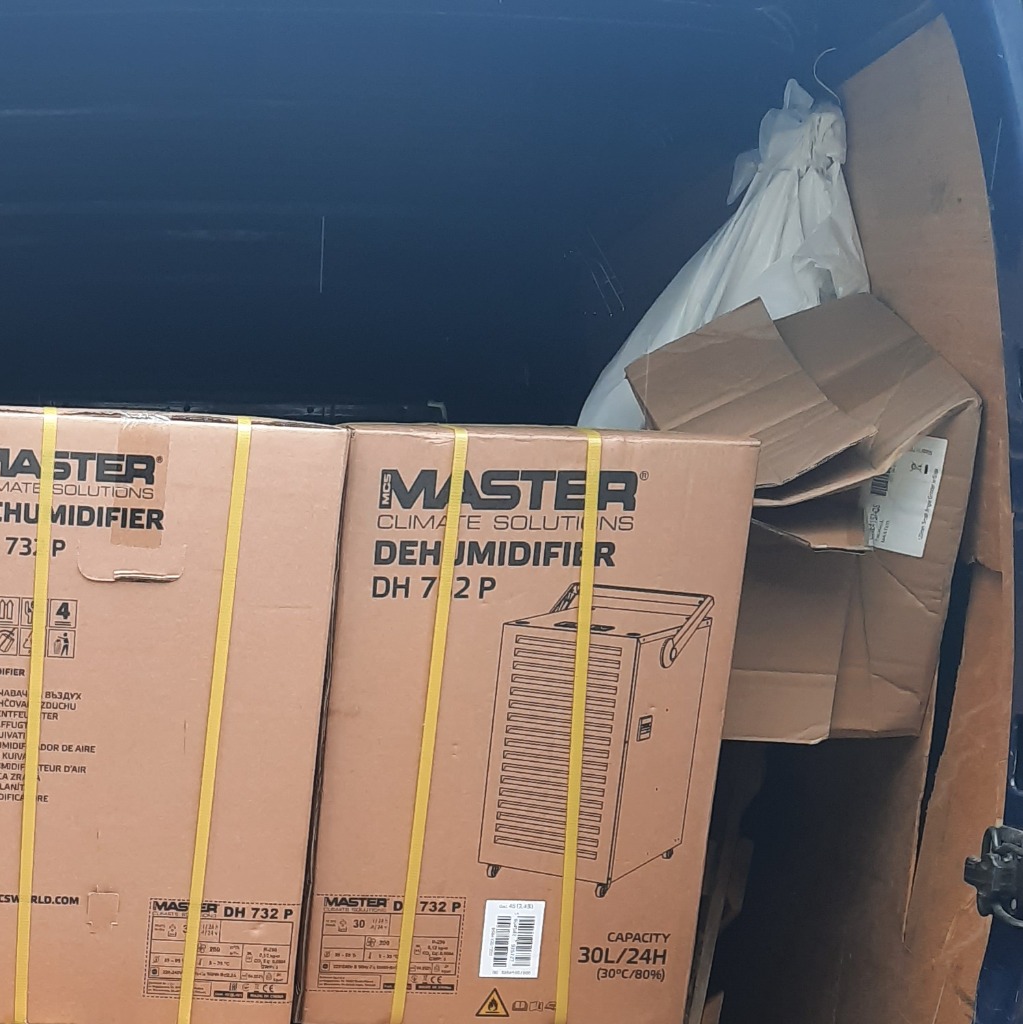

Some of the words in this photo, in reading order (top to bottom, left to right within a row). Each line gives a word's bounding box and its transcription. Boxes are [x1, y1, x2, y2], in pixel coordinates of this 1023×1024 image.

[52, 484, 154, 500] SOLUTIONS
[380, 472, 391, 505] MCS
[388, 469, 638, 511] MASTER
[493, 515, 634, 531] SOLUTINS
[5, 537, 40, 557] 73
[52, 539, 66, 557] P
[372, 576, 410, 598] DH
[421, 576, 471, 599] 72
[478, 576, 496, 599] P
[55, 602, 71, 620] 4
[74, 745, 96, 753] AIRE
[63, 765, 87, 774] D'AIR
[153, 901, 218, 913] MASER
[223, 906, 246, 918] DH
[251, 907, 279, 919] 732
[283, 909, 294, 920] P
[324, 897, 388, 908] MASTER
[419, 901, 447, 912] 732
[451, 901, 462, 913] P
[352, 919, 366, 929] 30
[606, 931, 671, 943] CAPACITY
[577, 946, 668, 965] 30L/24H
